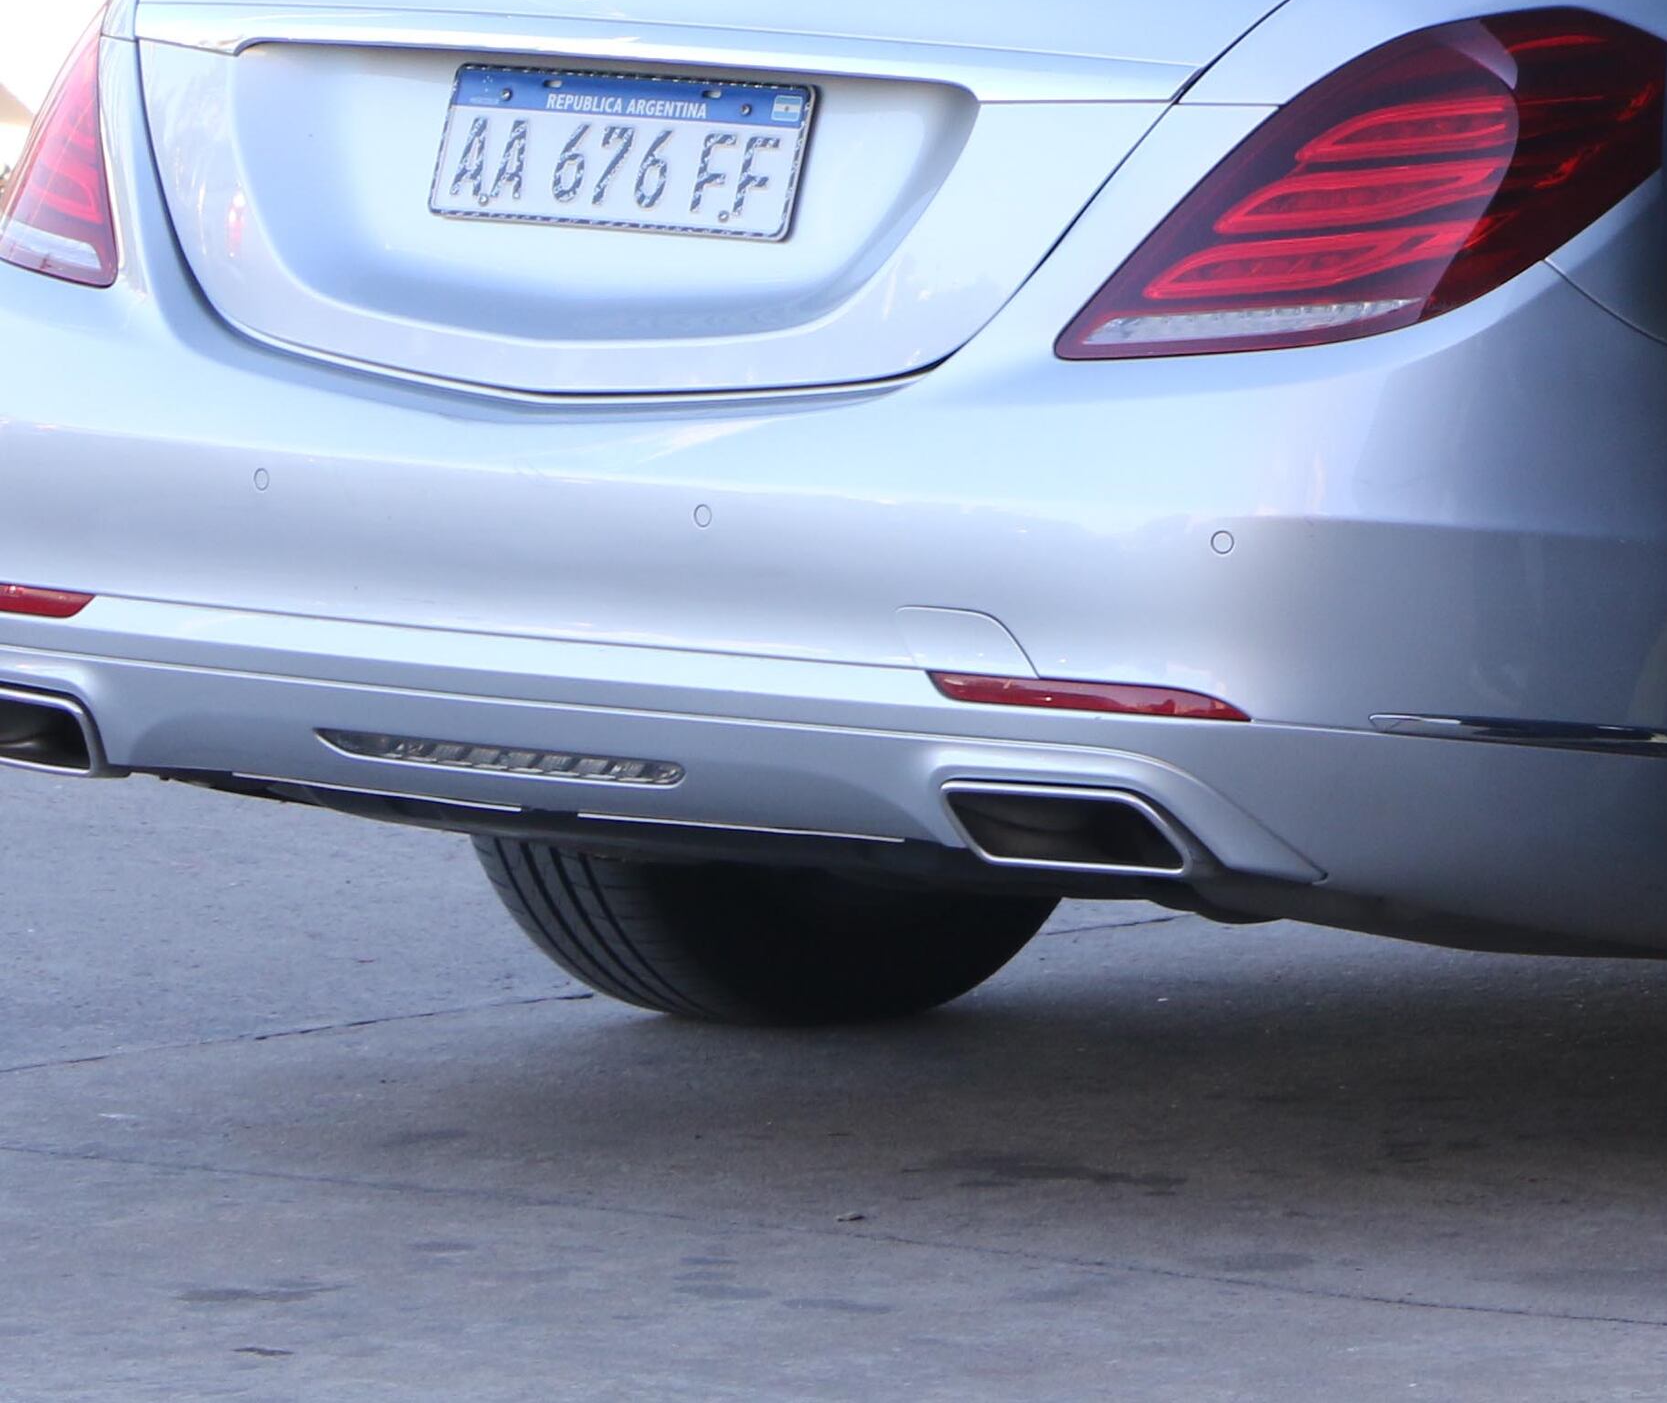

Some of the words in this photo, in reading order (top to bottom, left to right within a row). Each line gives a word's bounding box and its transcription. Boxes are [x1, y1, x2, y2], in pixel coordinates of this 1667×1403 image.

[546, 93, 622, 115] REPUBLICA
[625, 98, 706, 119] ARGENTINA
[449, 115, 530, 200] AA
[551, 123, 674, 211] 676
[689, 131, 781, 217] FF
